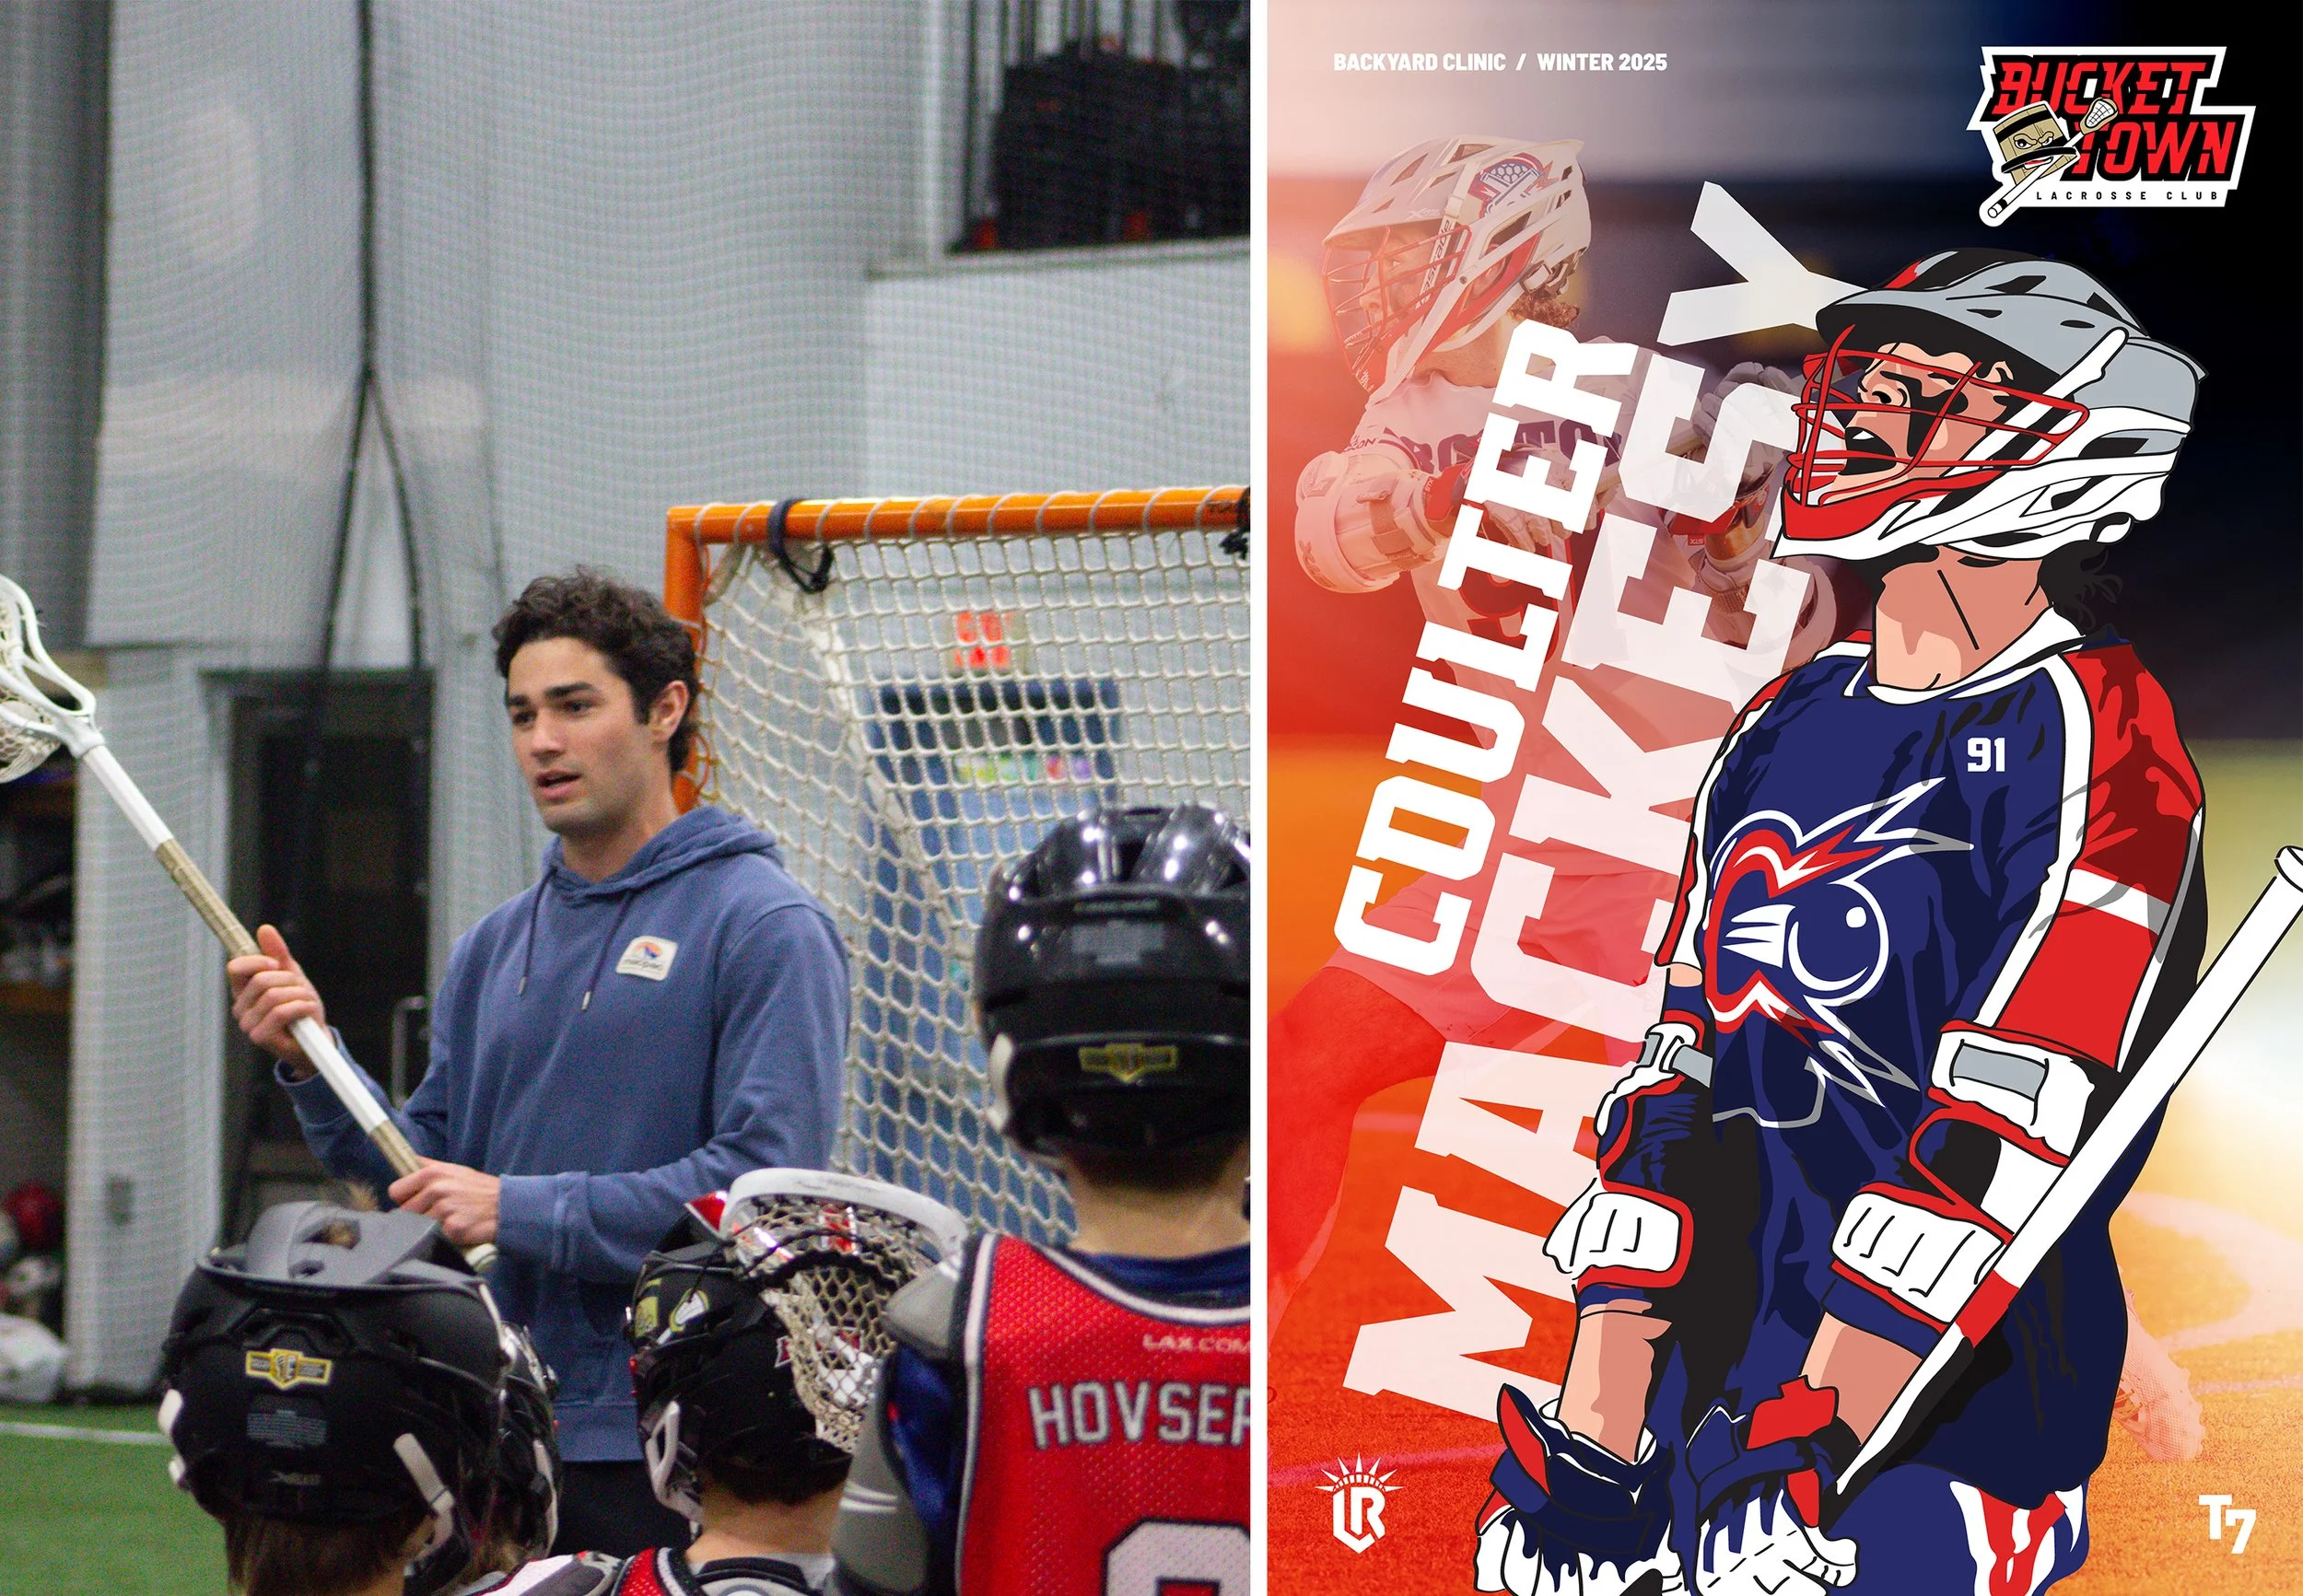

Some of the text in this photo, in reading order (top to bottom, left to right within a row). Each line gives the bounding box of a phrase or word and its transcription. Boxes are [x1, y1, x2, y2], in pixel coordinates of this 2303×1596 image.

[1334, 52, 1438, 71] BACKYARD
[1443, 52, 1506, 71] CLINIC
[1537, 52, 1614, 71] WINTER
[1619, 52, 1667, 71] 2025
[1991, 62, 2207, 115] BUCKET
[2071, 121, 2237, 174] TOWN
[2036, 191, 2217, 200] LACROSSE CLUB
[1334, 320, 1639, 976] COULTER
[1967, 738, 2005, 772] 91
[1343, 181, 1869, 1423] MACKESY
[2199, 1495, 2256, 1554] T7
